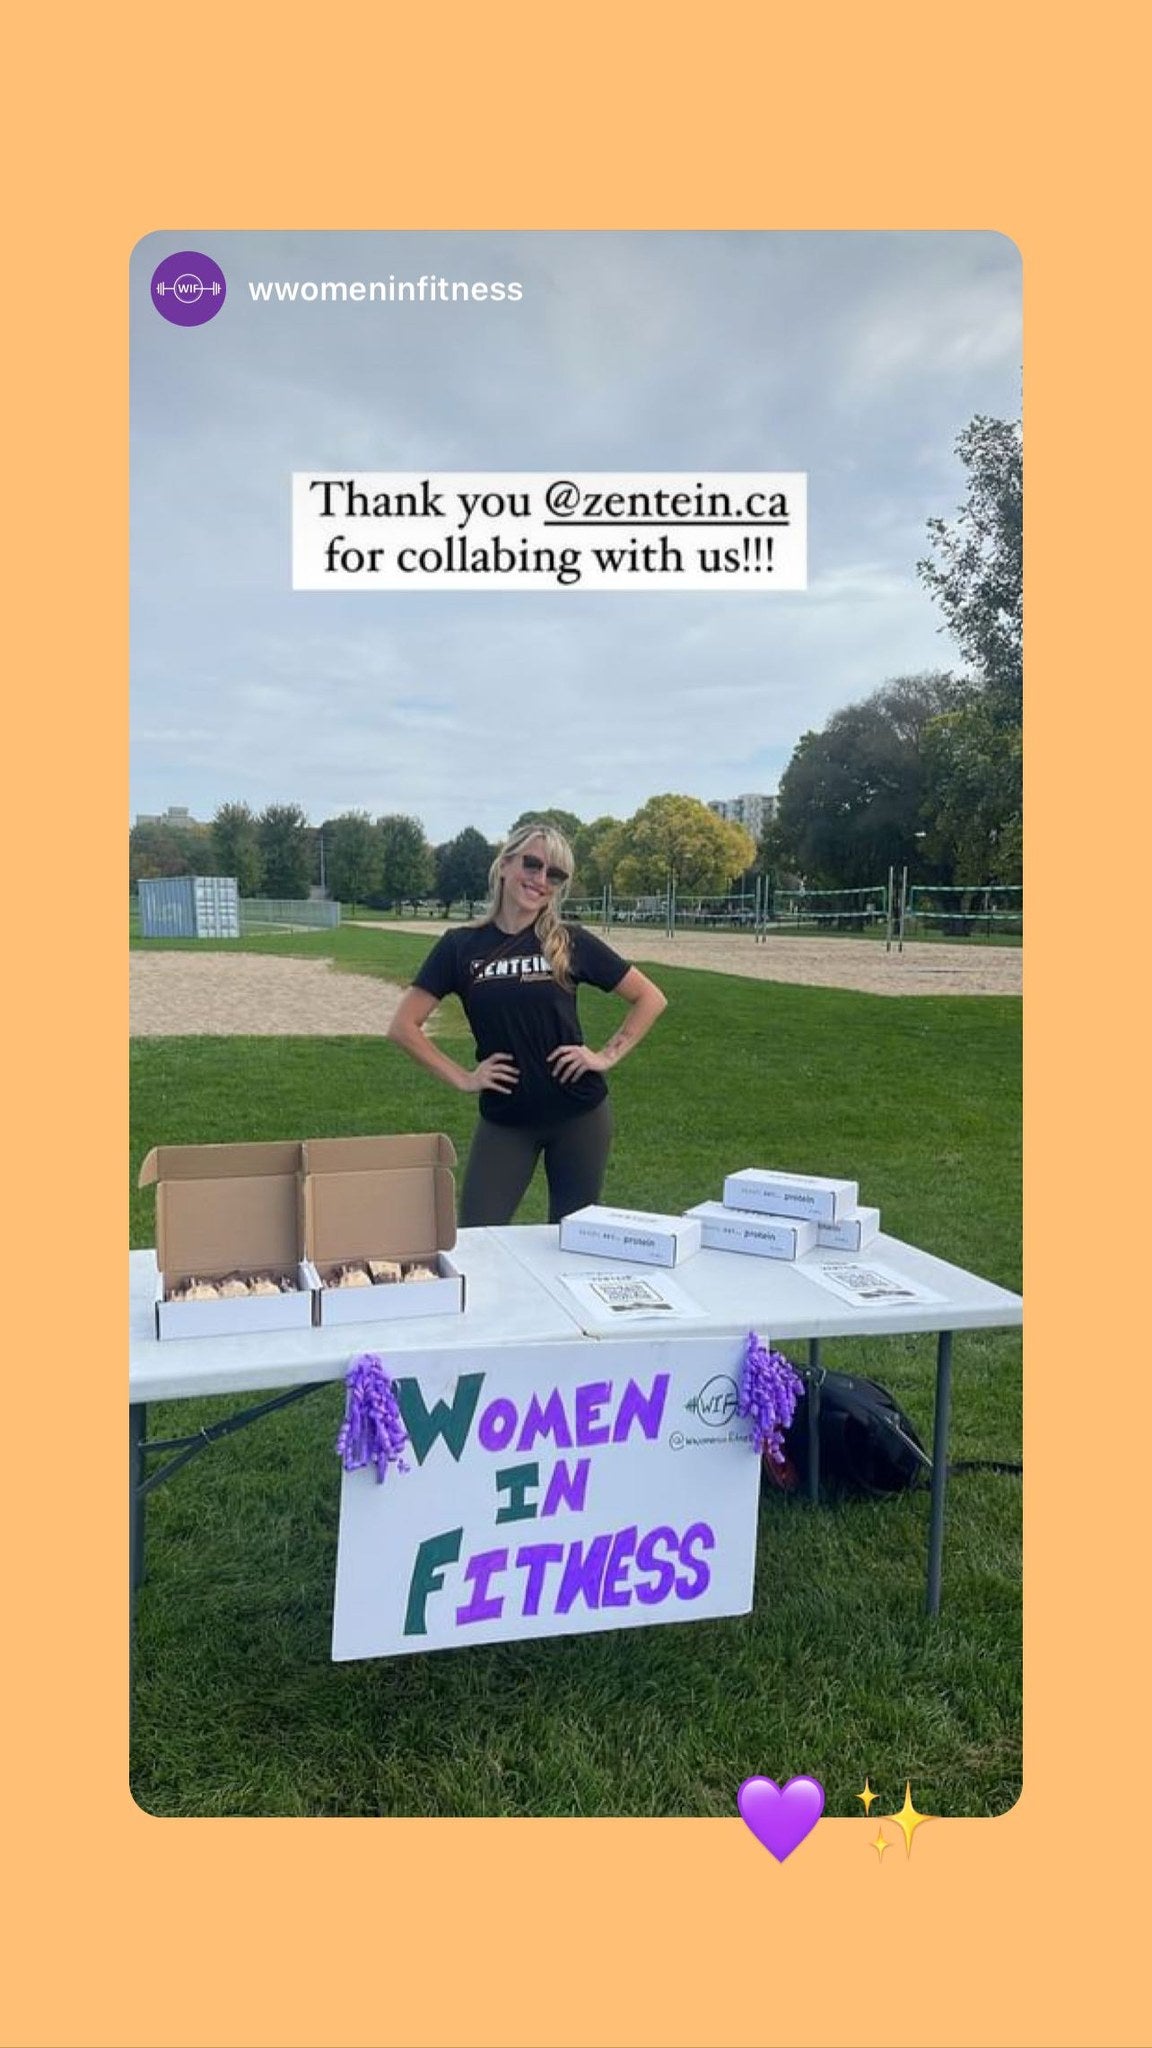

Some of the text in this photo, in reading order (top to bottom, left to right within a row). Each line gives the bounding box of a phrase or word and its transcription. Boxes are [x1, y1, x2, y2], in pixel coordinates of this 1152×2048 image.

[395, 1372, 670, 1466] WOMEN
[495, 1458, 592, 1525] IN
[403, 1522, 715, 1636] FITNESS
